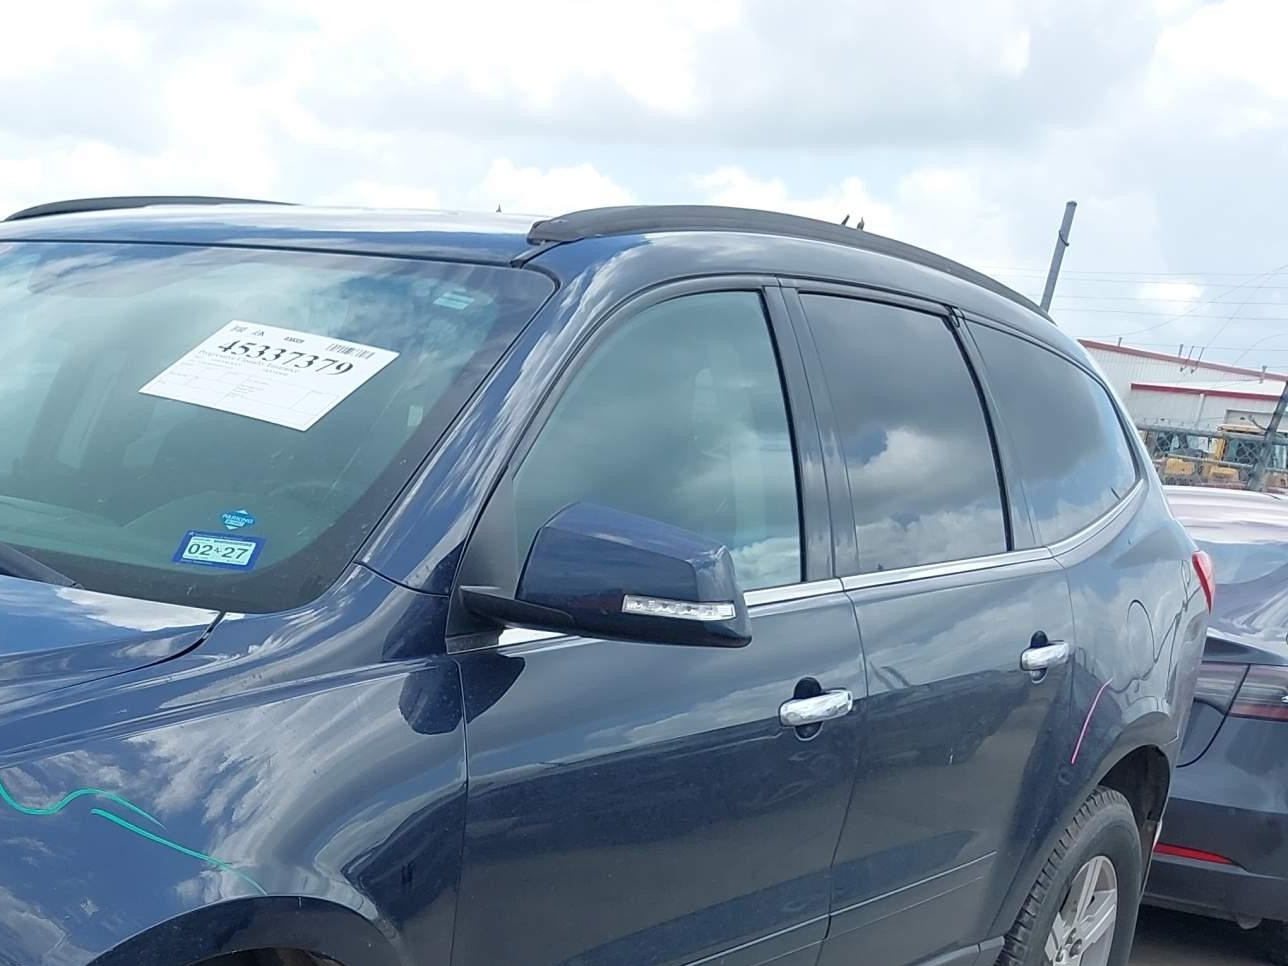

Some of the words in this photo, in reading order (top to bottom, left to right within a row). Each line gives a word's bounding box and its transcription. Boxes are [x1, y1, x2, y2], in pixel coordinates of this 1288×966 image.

[218, 339, 354, 376] 45337379
[187, 543, 213, 556] 02
[221, 547, 249, 560] 27
